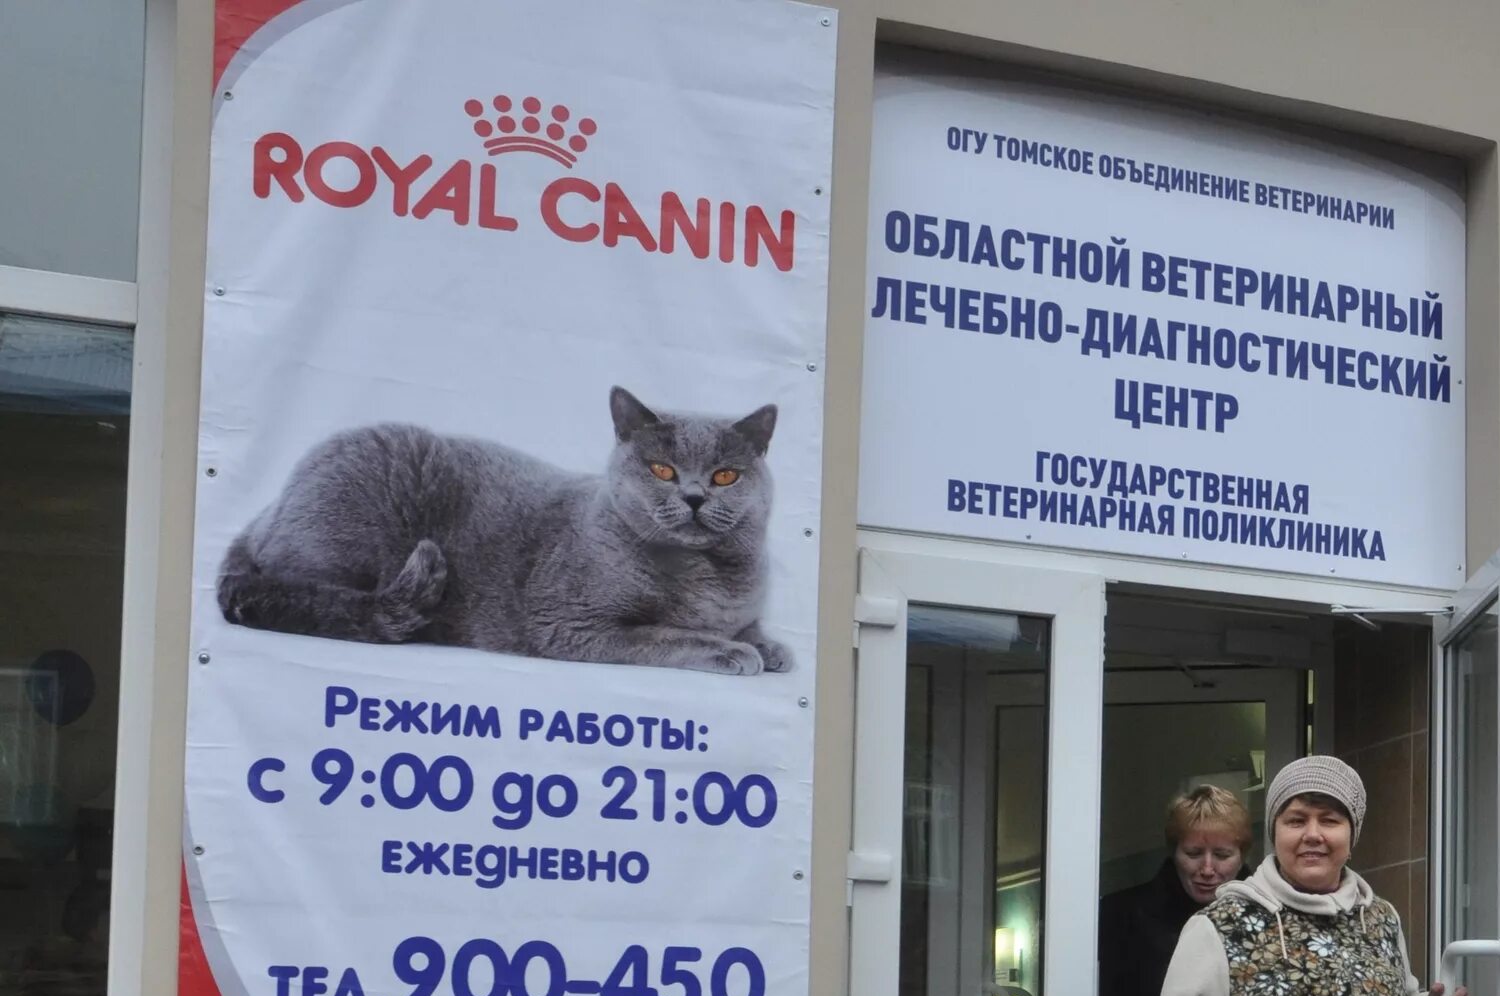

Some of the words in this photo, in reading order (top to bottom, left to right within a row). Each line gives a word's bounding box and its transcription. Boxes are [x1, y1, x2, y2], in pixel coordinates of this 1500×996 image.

[254, 133, 520, 231] ROYAL
[542, 178, 794, 271] CANIN
[947, 126, 988, 156] ОГУ
[993, 134, 1094, 175] ТОМСКОЕ
[1098, 154, 1250, 203] ОБЪЕДИНЕНИЕ
[1254, 182, 1395, 230] ВЕТЕРИНАРИИ
[884, 210, 1130, 289] ОБЛАСТНОЙ
[1141, 251, 1443, 341] ВЕТЕРИНАРНЫЙ
[871, 276, 1451, 404] ЛЕЧЕБНО-ДИАГНОСТИЧЕСКИЙ
[1114, 378, 1239, 434] ЦЕНТР
[947, 478, 1175, 537] ВЕТЕРИНАРНАЯ
[1183, 506, 1386, 562] ПОЛИКЛИНИКА
[1035, 450, 1309, 516] ГОСУДАРСТВЕННАЯ
[311, 747, 474, 813] 9:00
[599, 765, 778, 829] 21:00
